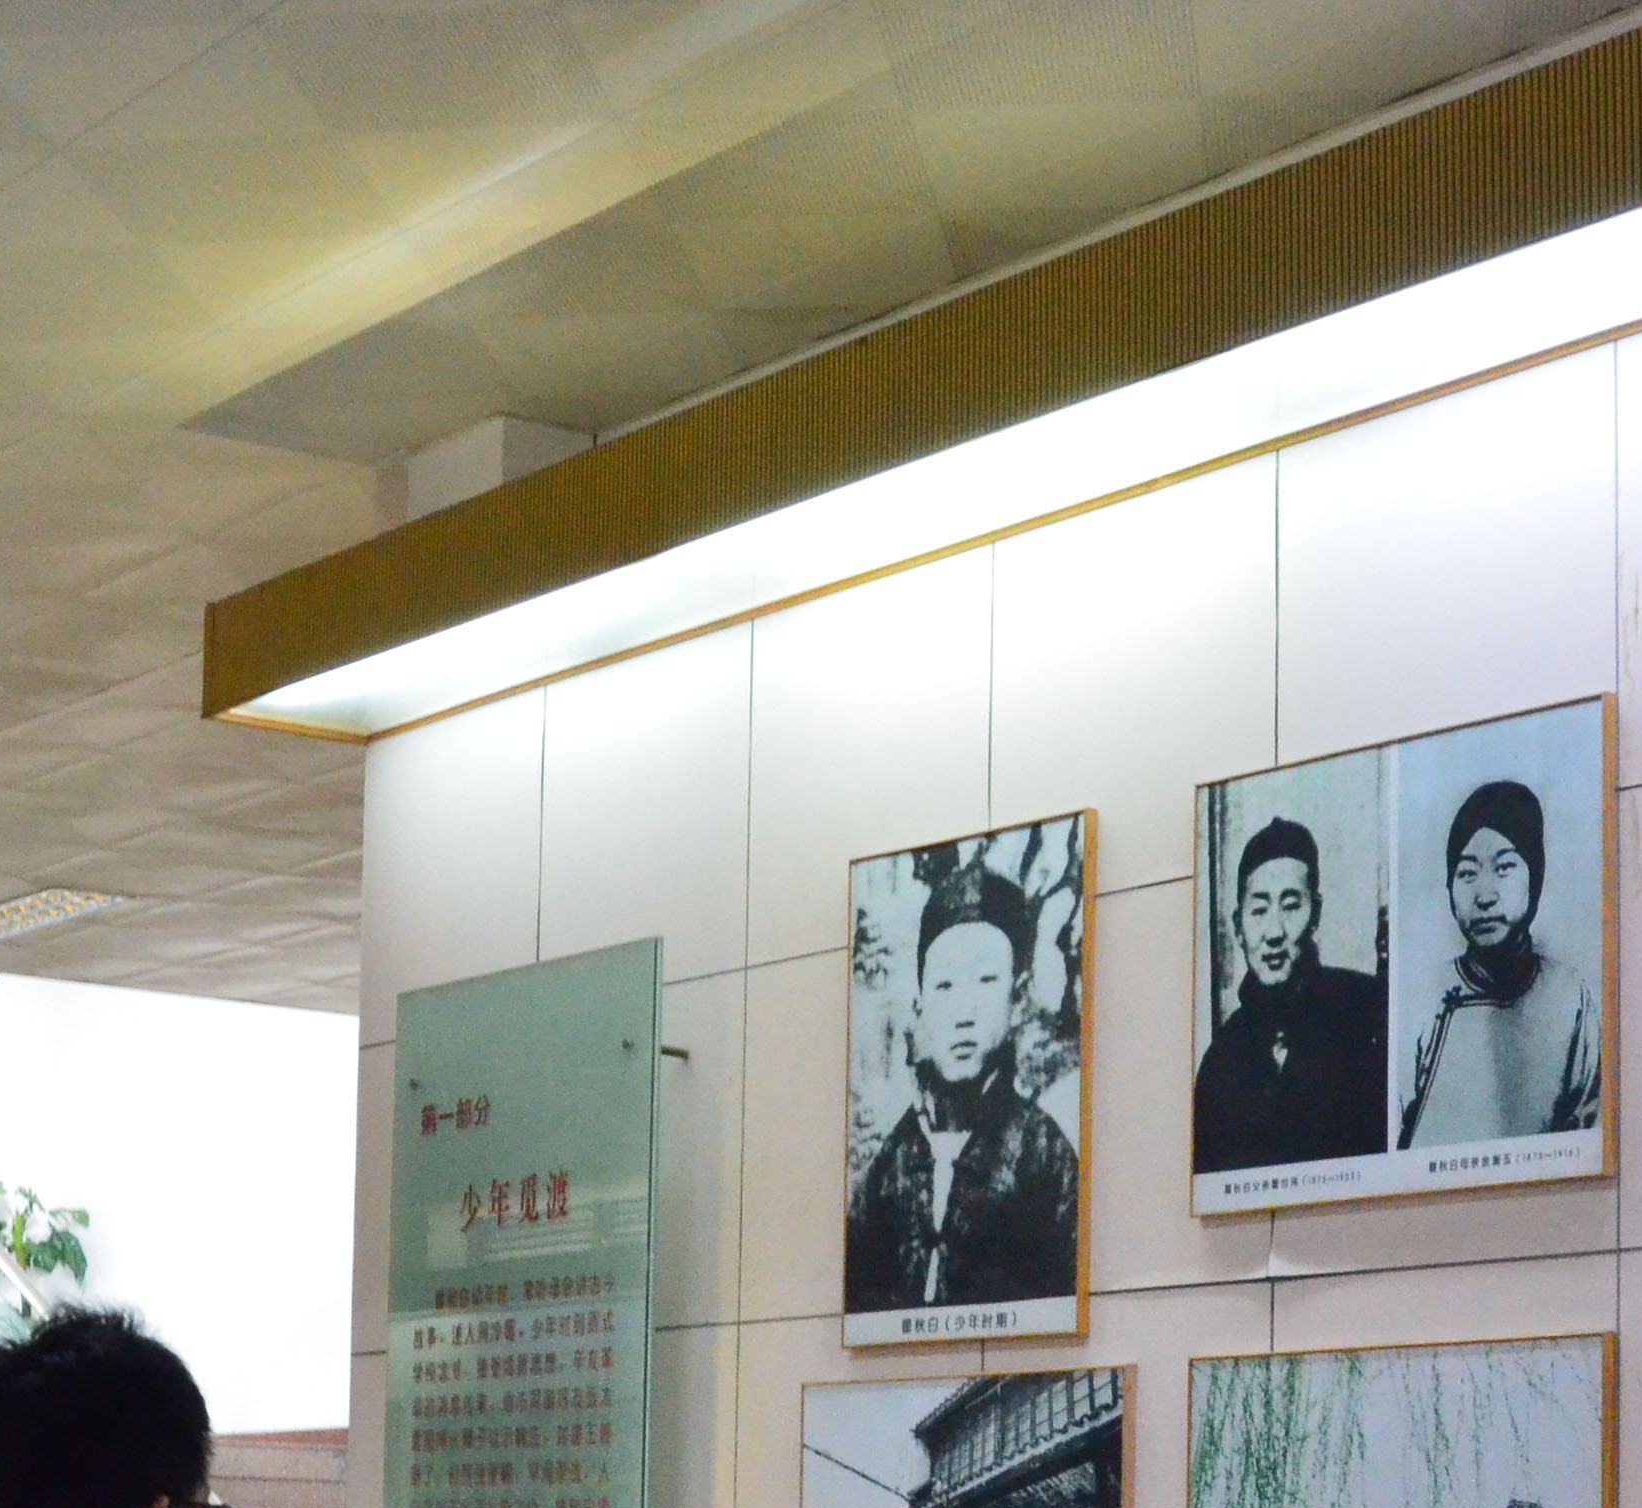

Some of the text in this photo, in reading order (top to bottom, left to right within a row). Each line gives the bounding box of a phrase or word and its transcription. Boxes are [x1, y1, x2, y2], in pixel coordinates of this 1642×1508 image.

[420, 1094, 492, 1136] 第一部分
[460, 1170, 569, 1233] 少年觅渡
